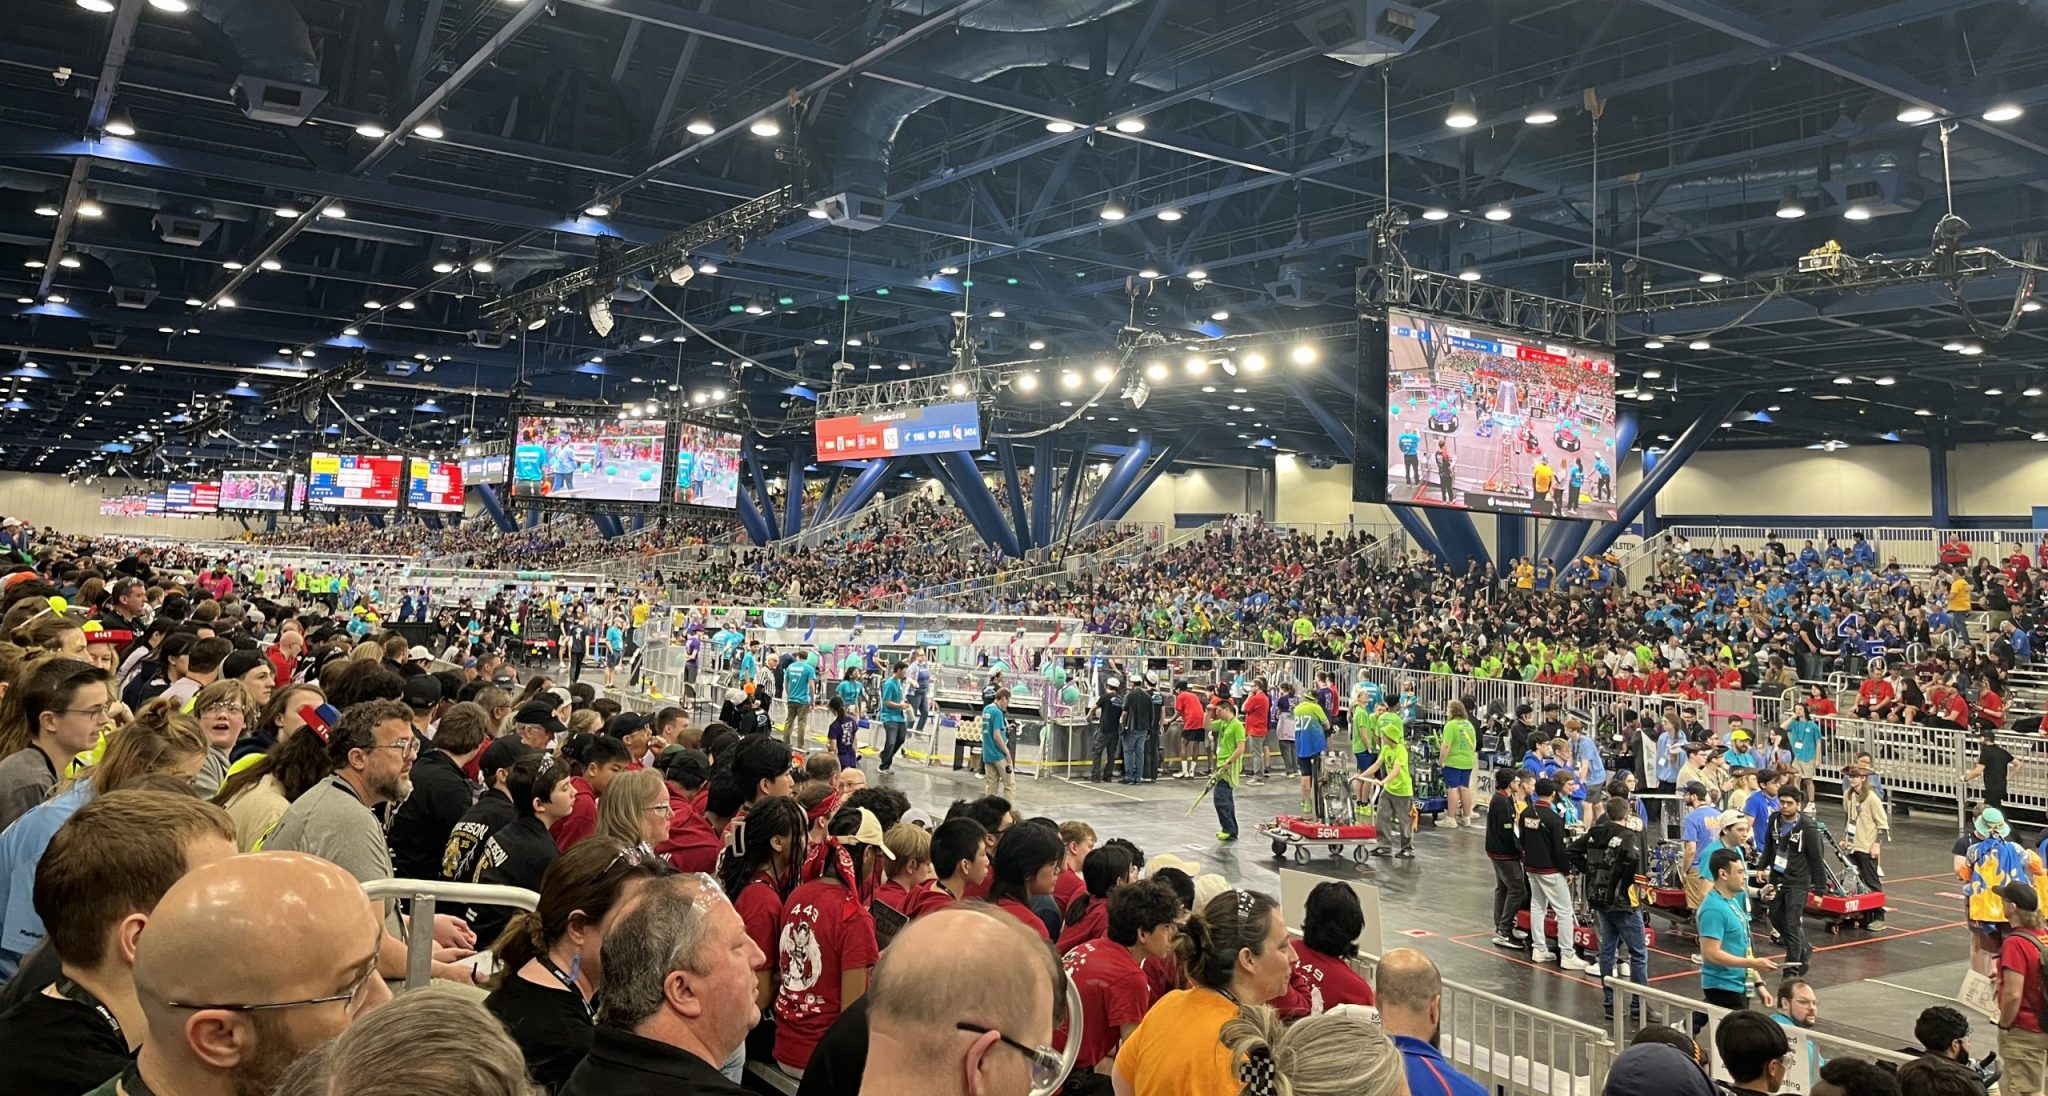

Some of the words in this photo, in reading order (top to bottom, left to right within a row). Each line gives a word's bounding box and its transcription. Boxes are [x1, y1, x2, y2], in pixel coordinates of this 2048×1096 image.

[1295, 715, 1312, 731] 217
[1317, 828, 1340, 839] 5614
[791, 903, 819, 923] 449
